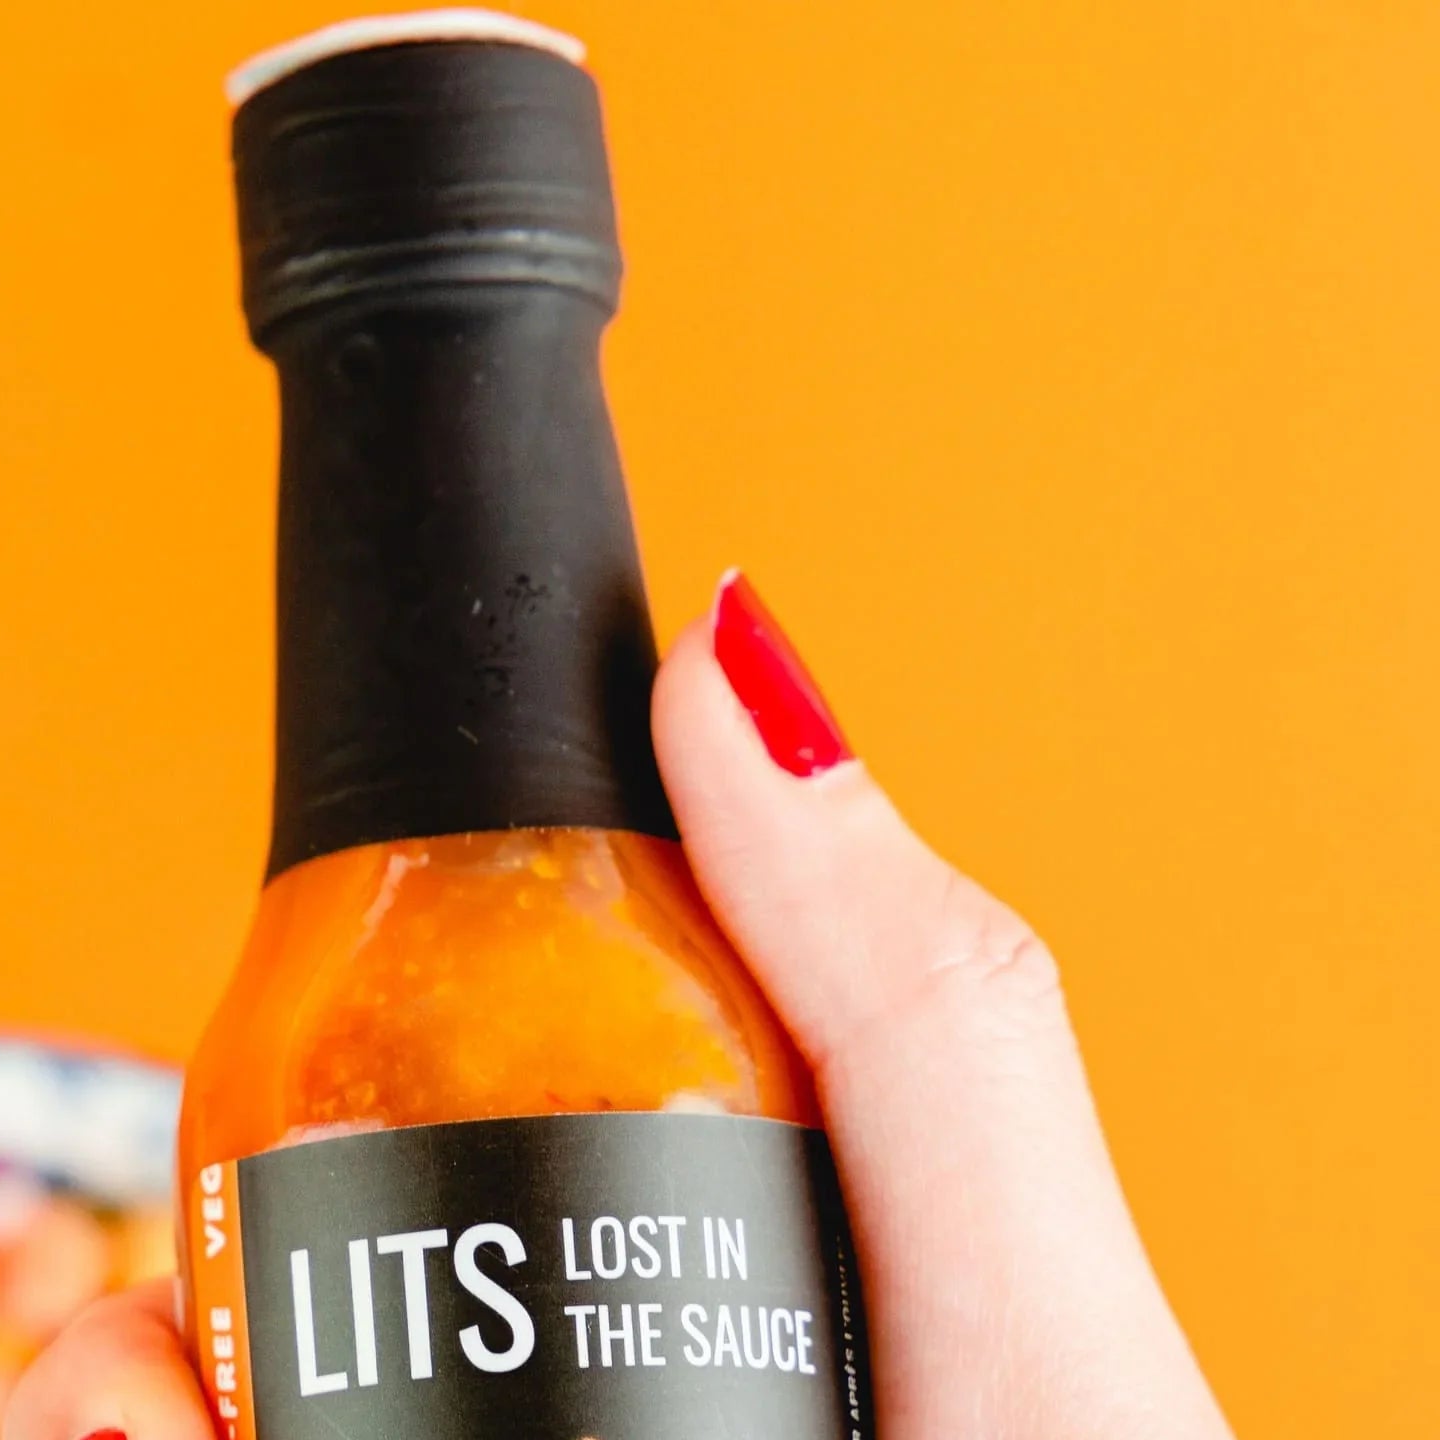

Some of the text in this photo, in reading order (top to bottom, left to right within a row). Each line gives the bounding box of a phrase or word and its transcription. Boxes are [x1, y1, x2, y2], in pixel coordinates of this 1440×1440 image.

[563, 1216, 748, 1281] LOST IN
[289, 1223, 535, 1397] LITS
[563, 1304, 817, 1376] THE SAUCE
